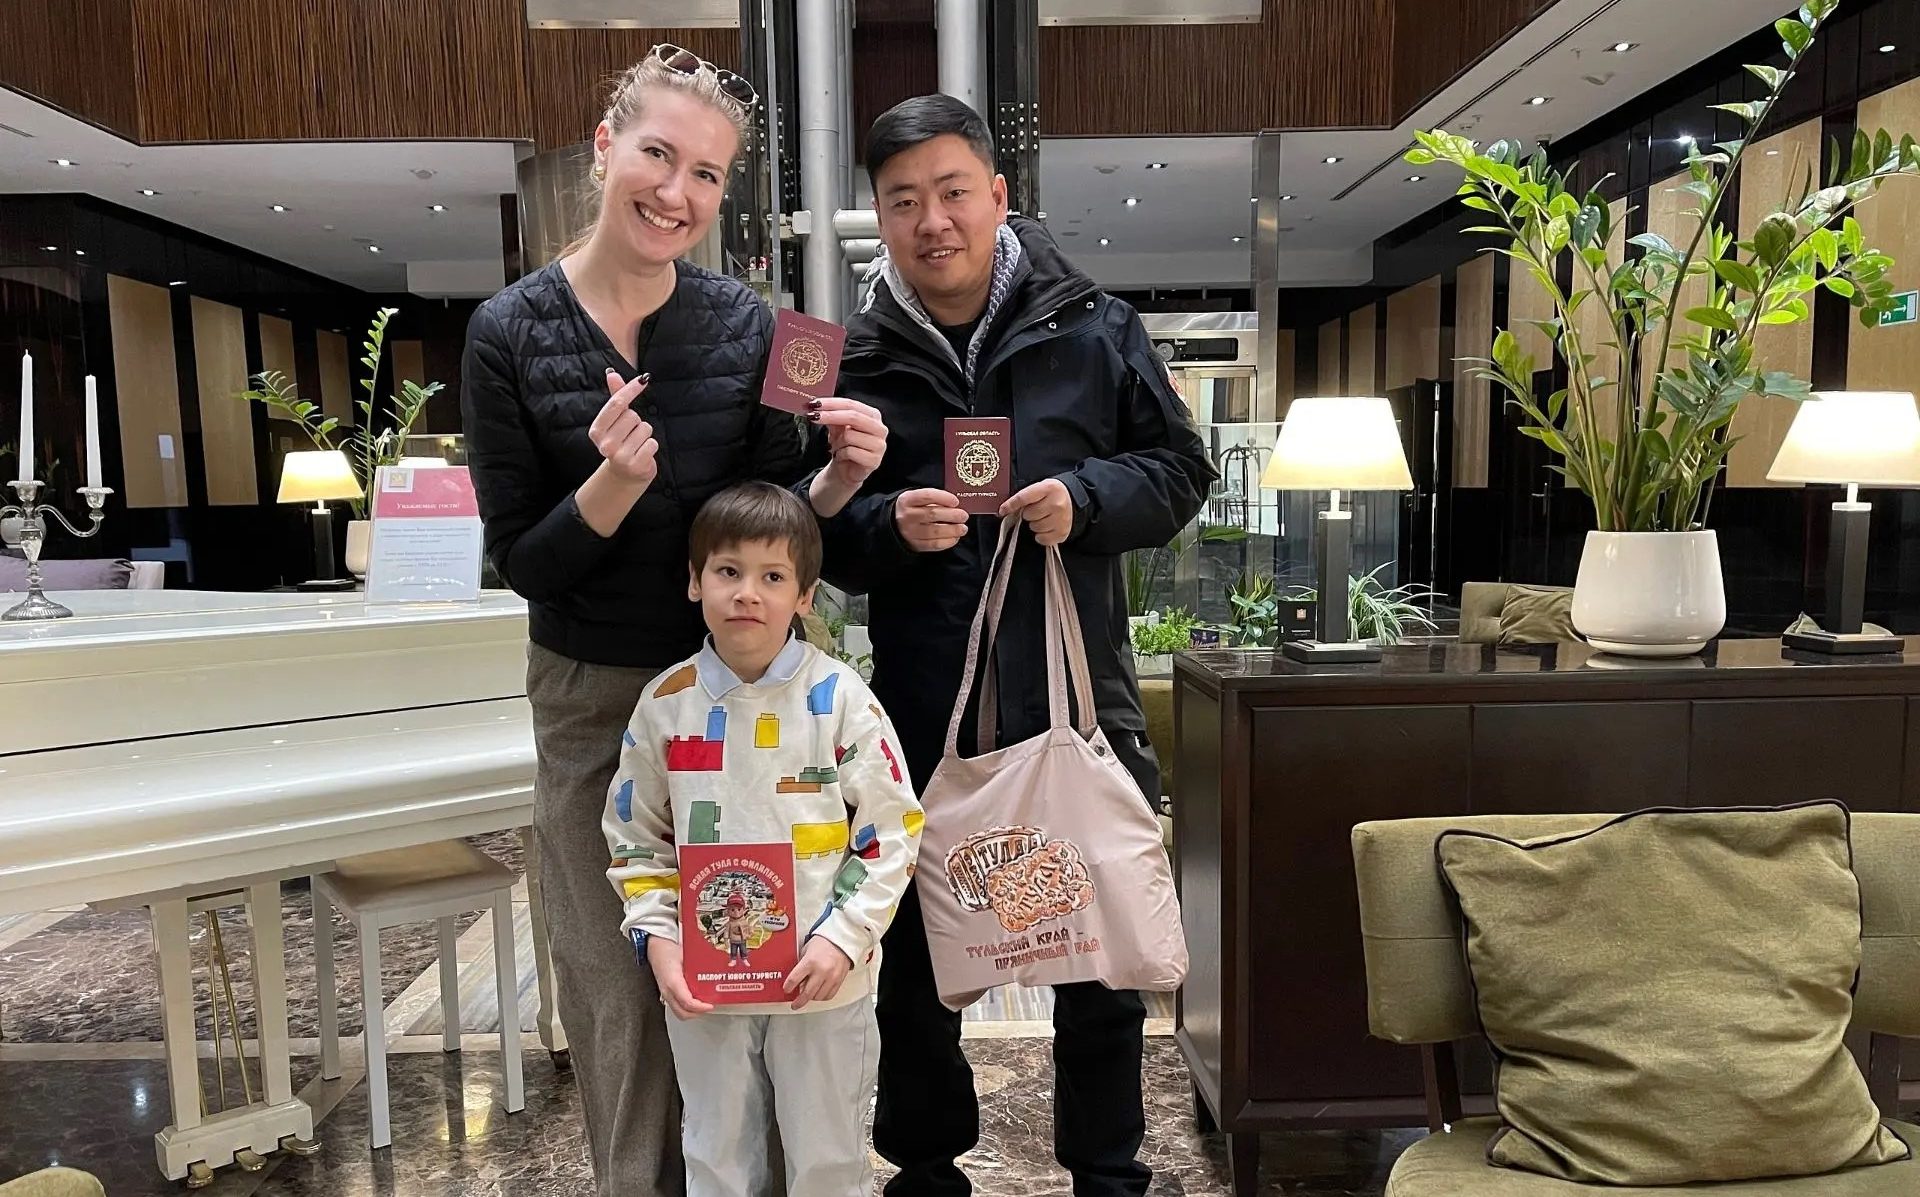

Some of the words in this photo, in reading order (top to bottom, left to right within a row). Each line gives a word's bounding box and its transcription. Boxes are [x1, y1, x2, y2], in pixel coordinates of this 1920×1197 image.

[710, 858, 732, 871] ТУЛА
[733, 858, 739, 866] С
[741, 858, 785, 889] ФИЛИПКОМ
[965, 935, 1030, 959] ТУЛЬСКИЙ
[1036, 927, 1070, 946] КРАЙ
[994, 943, 1069, 971] ПРЯНИЧНЫЙ
[1073, 937, 1101, 955] РАЙ
[697, 973, 726, 981] ПАСПОРТ
[728, 972, 751, 981] ЮНОГО
[752, 971, 782, 980] ТУРИСТА
